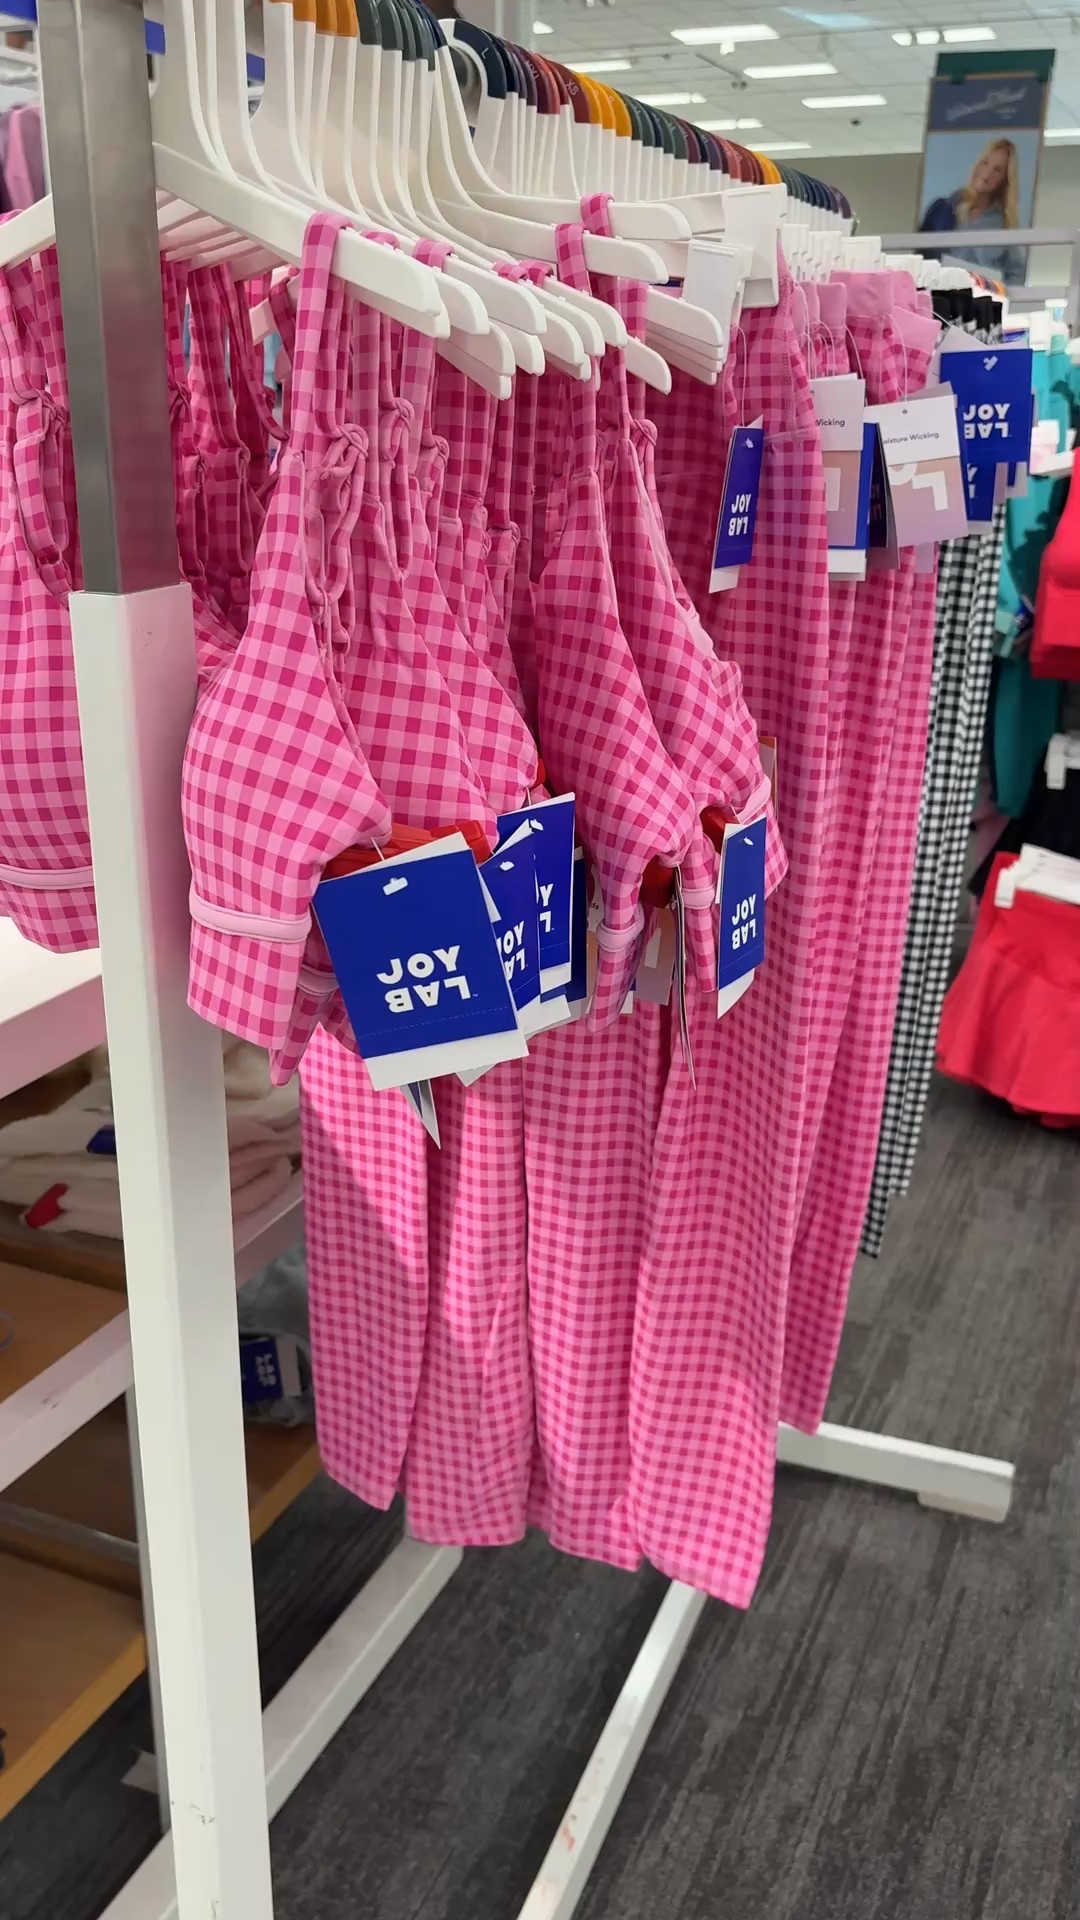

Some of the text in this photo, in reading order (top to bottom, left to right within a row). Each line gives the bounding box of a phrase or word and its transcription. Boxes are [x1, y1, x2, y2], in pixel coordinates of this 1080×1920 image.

[963, 403, 1011, 421] JOY
[881, 431, 940, 445] oisture Wicking
[731, 493, 752, 514] JOY
[728, 516, 749, 537] LAB
[731, 893, 756, 926] JOY
[731, 918, 757, 950] LAB
[376, 945, 461, 985] JOY
[504, 947, 527, 982] LA
[384, 975, 472, 1014] LAB
